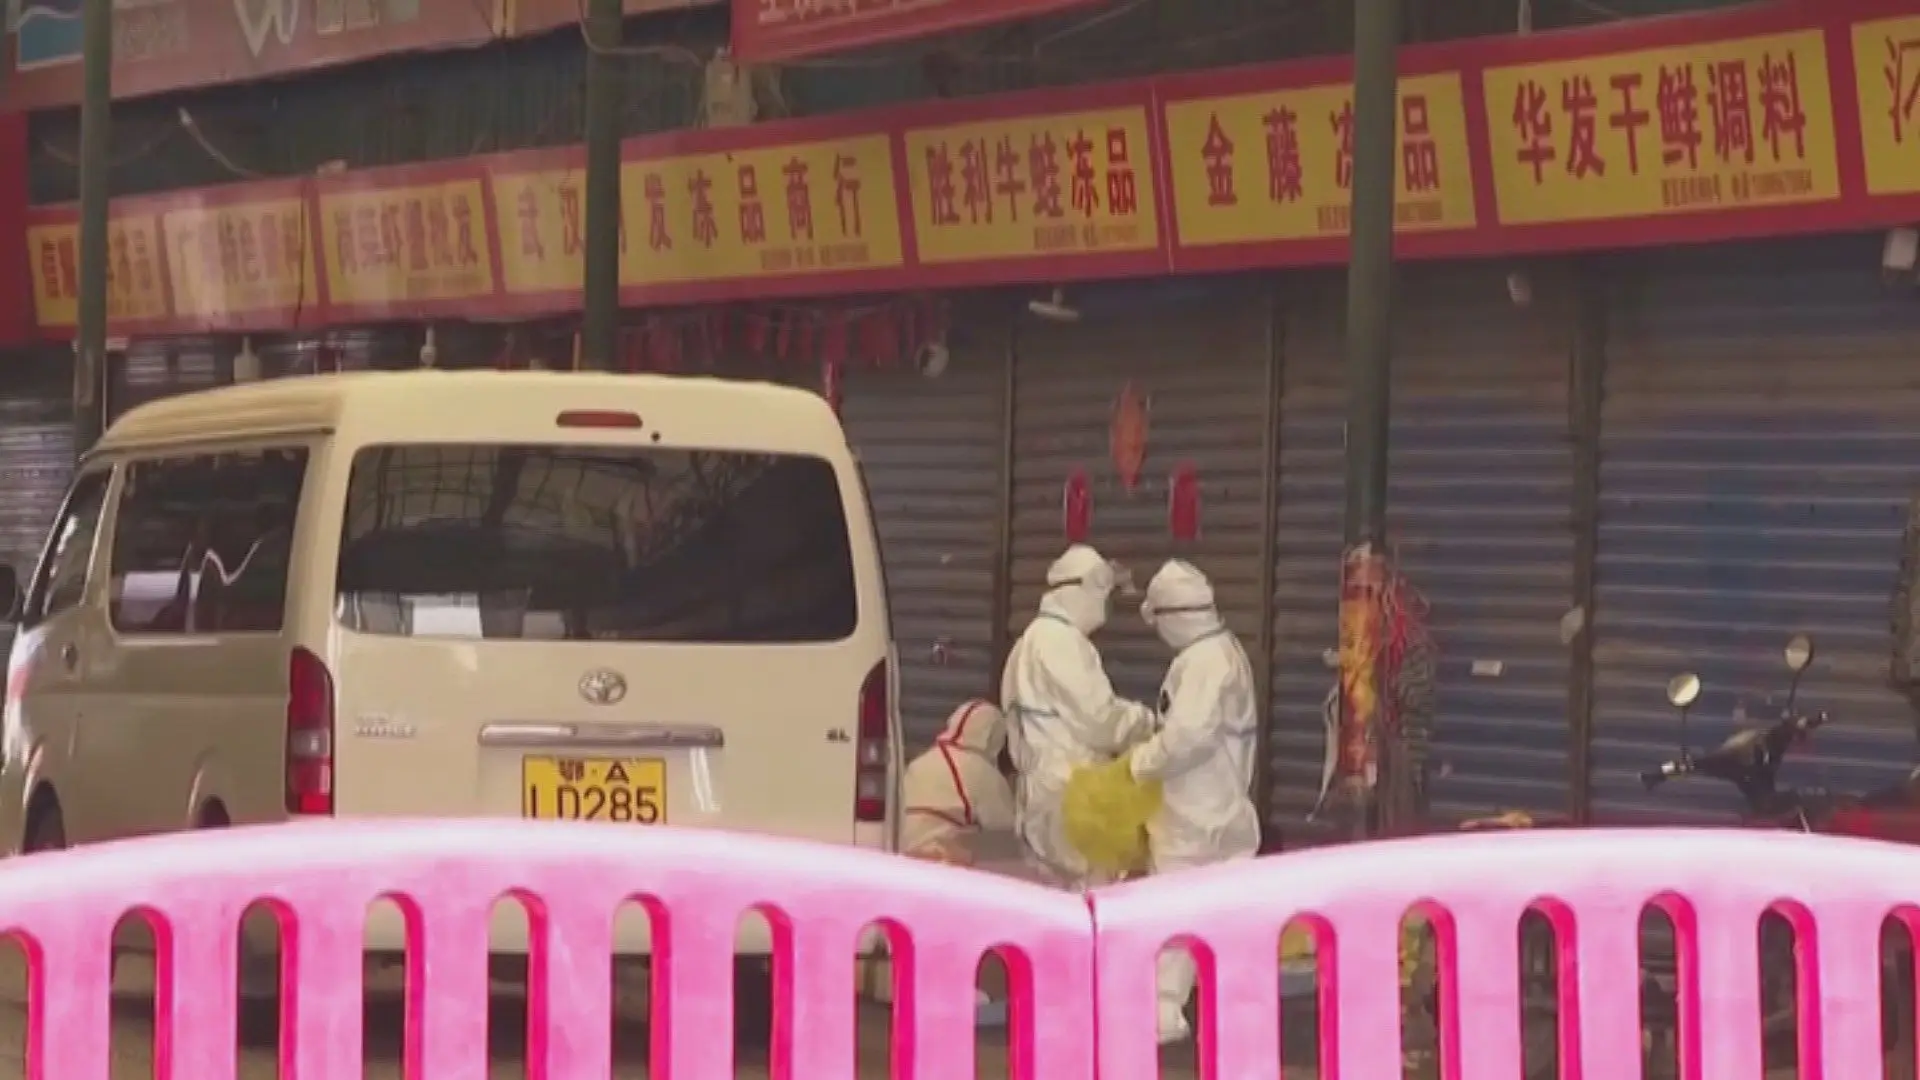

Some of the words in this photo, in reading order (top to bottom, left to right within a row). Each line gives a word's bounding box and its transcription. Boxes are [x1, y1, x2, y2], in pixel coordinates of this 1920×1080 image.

[1512, 49, 1807, 185] 华发干鲜调料
[517, 153, 862, 262] 武汉发冻品商行
[925, 129, 1138, 226] 胜利牛蛙冻品
